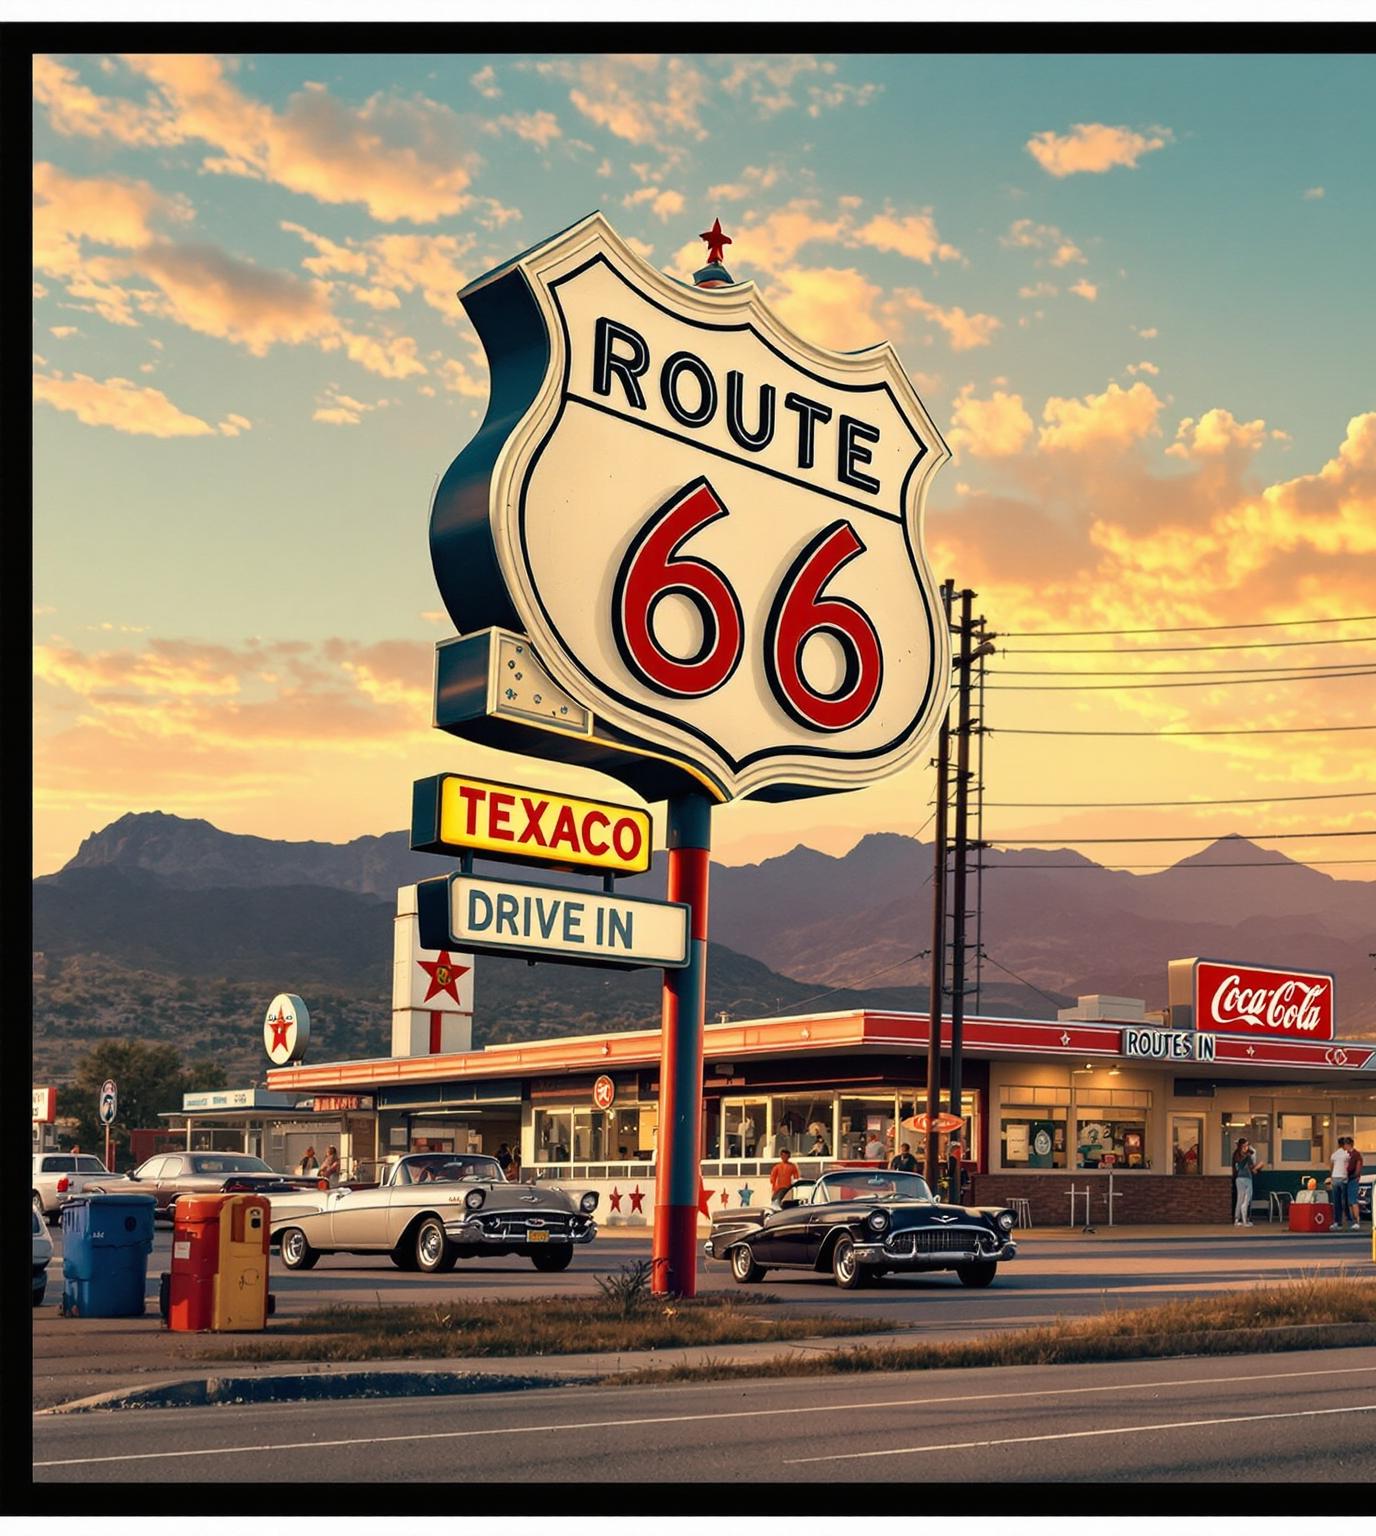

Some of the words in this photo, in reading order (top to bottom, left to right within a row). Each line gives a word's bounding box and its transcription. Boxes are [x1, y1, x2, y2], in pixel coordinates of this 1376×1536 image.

[593, 316, 881, 495] ROUTE
[611, 475, 884, 733] 66
[459, 786, 642, 861] TEXACO
[468, 889, 585, 943] DRIVE
[596, 907, 633, 949] IN
[1211, 974, 1328, 1031] Coca-Cola
[1126, 1029, 1192, 1057] ROUTES
[1196, 1032, 1216, 1061] IN
